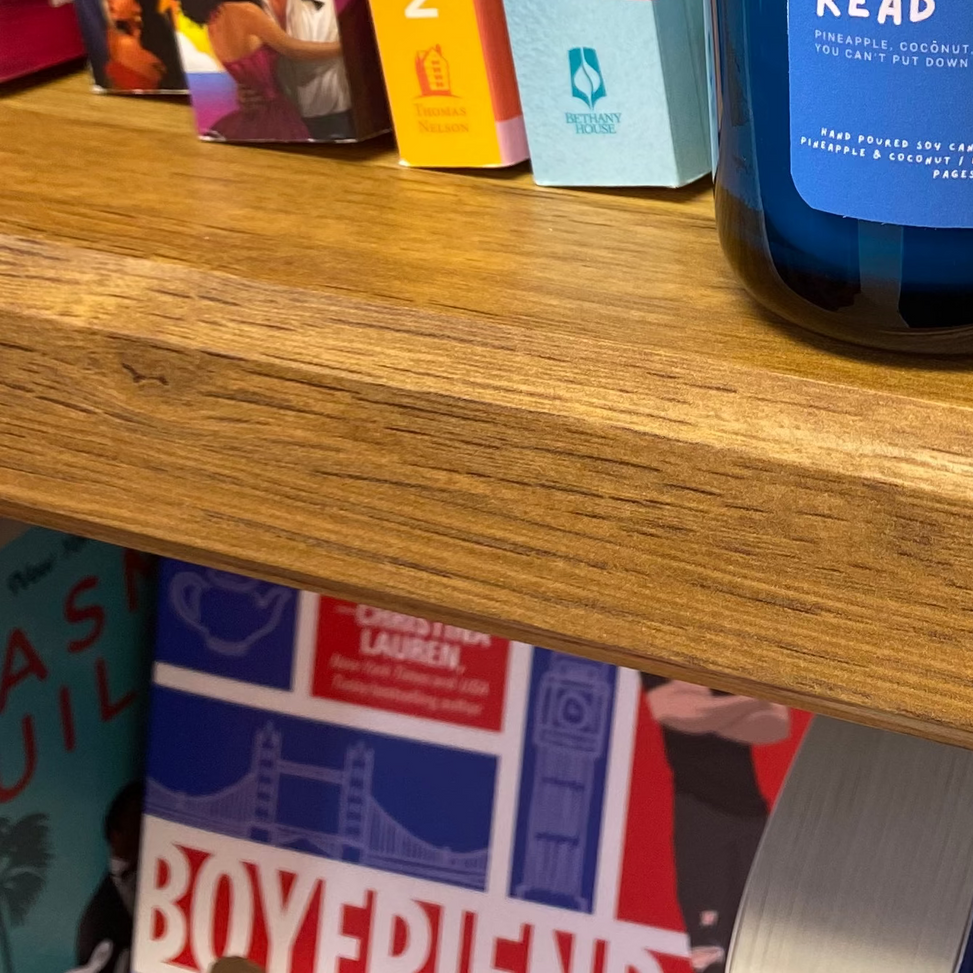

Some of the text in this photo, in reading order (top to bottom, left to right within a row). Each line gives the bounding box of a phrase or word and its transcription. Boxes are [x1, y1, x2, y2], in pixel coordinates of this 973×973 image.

[814, 29, 894, 52] PINEAPPLE,
[814, 43, 969, 69] YOU CAN'T PUT DOWN
[565, 112, 622, 125] BETHANY
[575, 123, 617, 135] HOUSE
[800, 136, 867, 158] PINEAPPLE
[872, 149, 882, 160] &
[888, 152, 951, 166] COCONUT
[820, 127, 851, 141] HAND
[858, 134, 909, 148] POURED
[916, 140, 942, 152] SOY
[137, 835, 666, 973] BOYFRI
